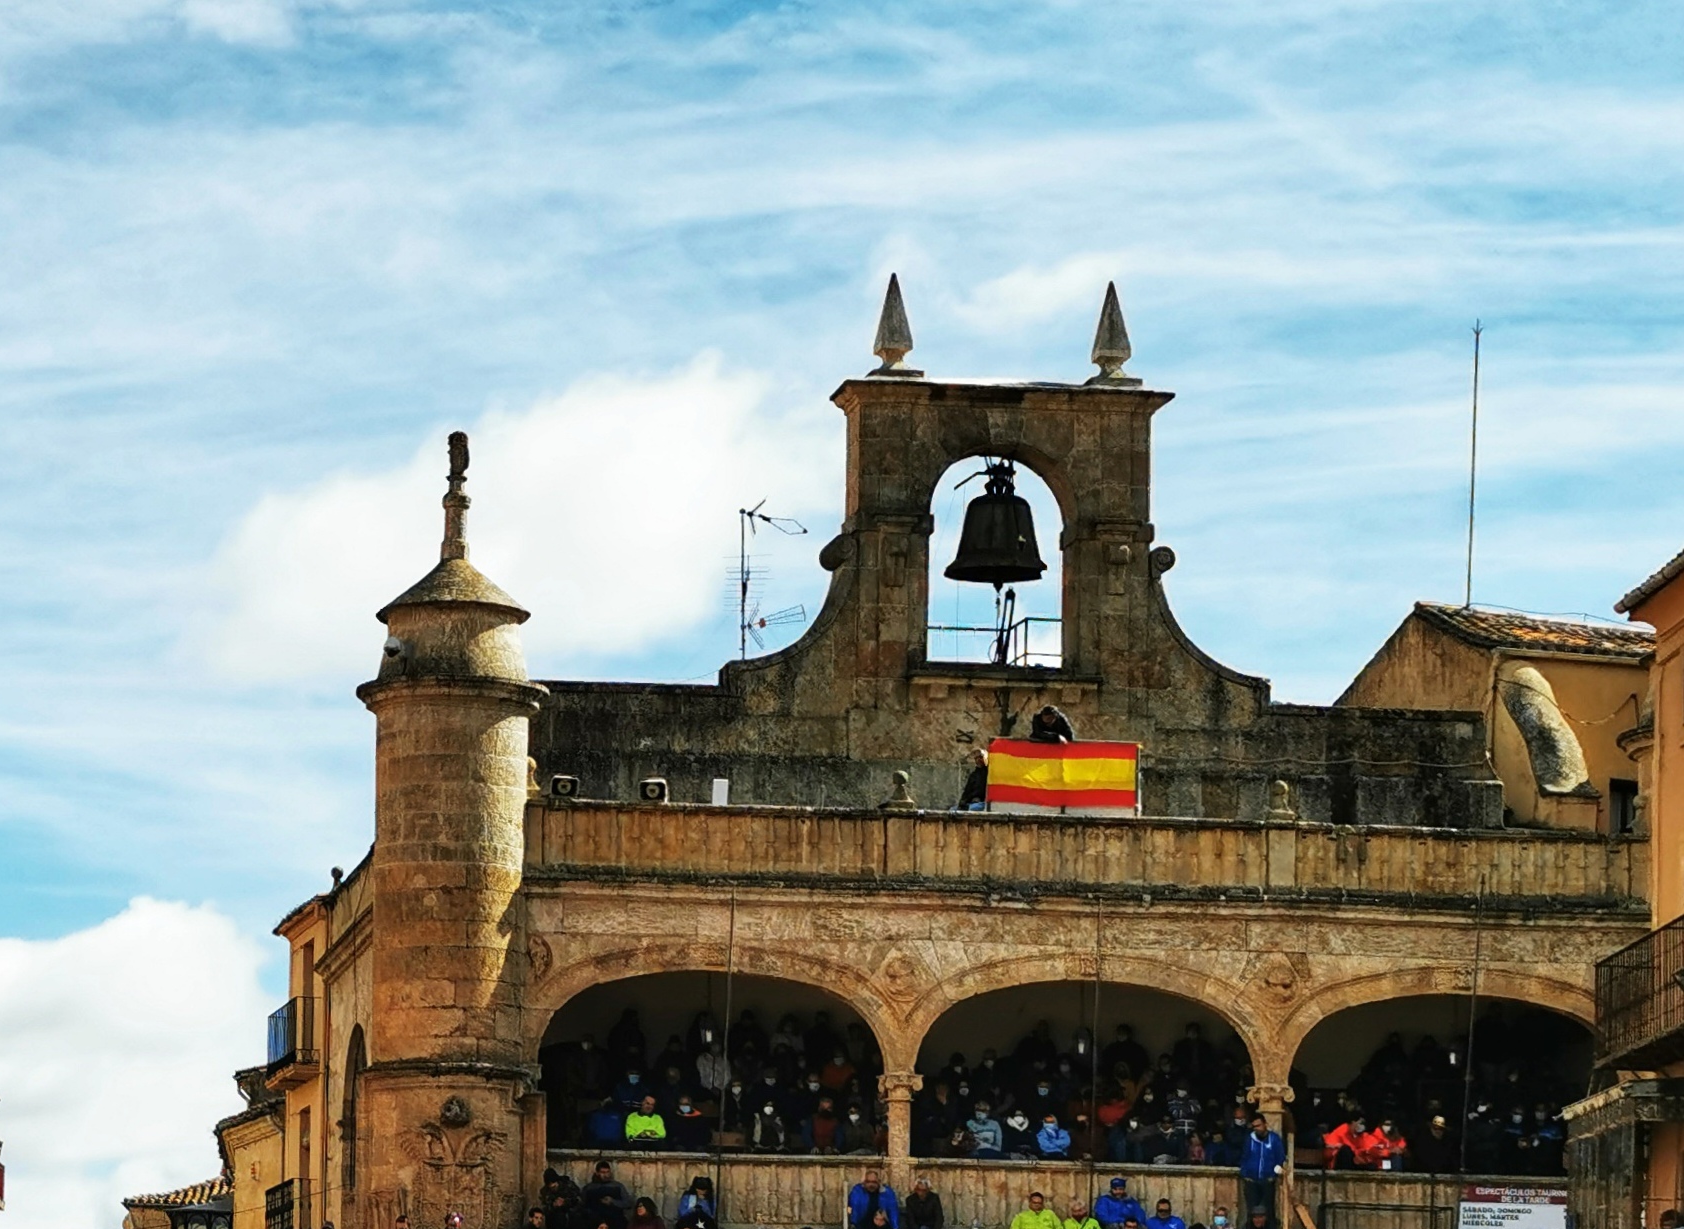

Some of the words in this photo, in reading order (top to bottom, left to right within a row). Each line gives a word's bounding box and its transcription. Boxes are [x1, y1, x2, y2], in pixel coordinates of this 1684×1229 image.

[1501, 1195, 1512, 1203] DE
[1512, 1196, 1524, 1204] LA
[1525, 1196, 1550, 1204] TARDE
